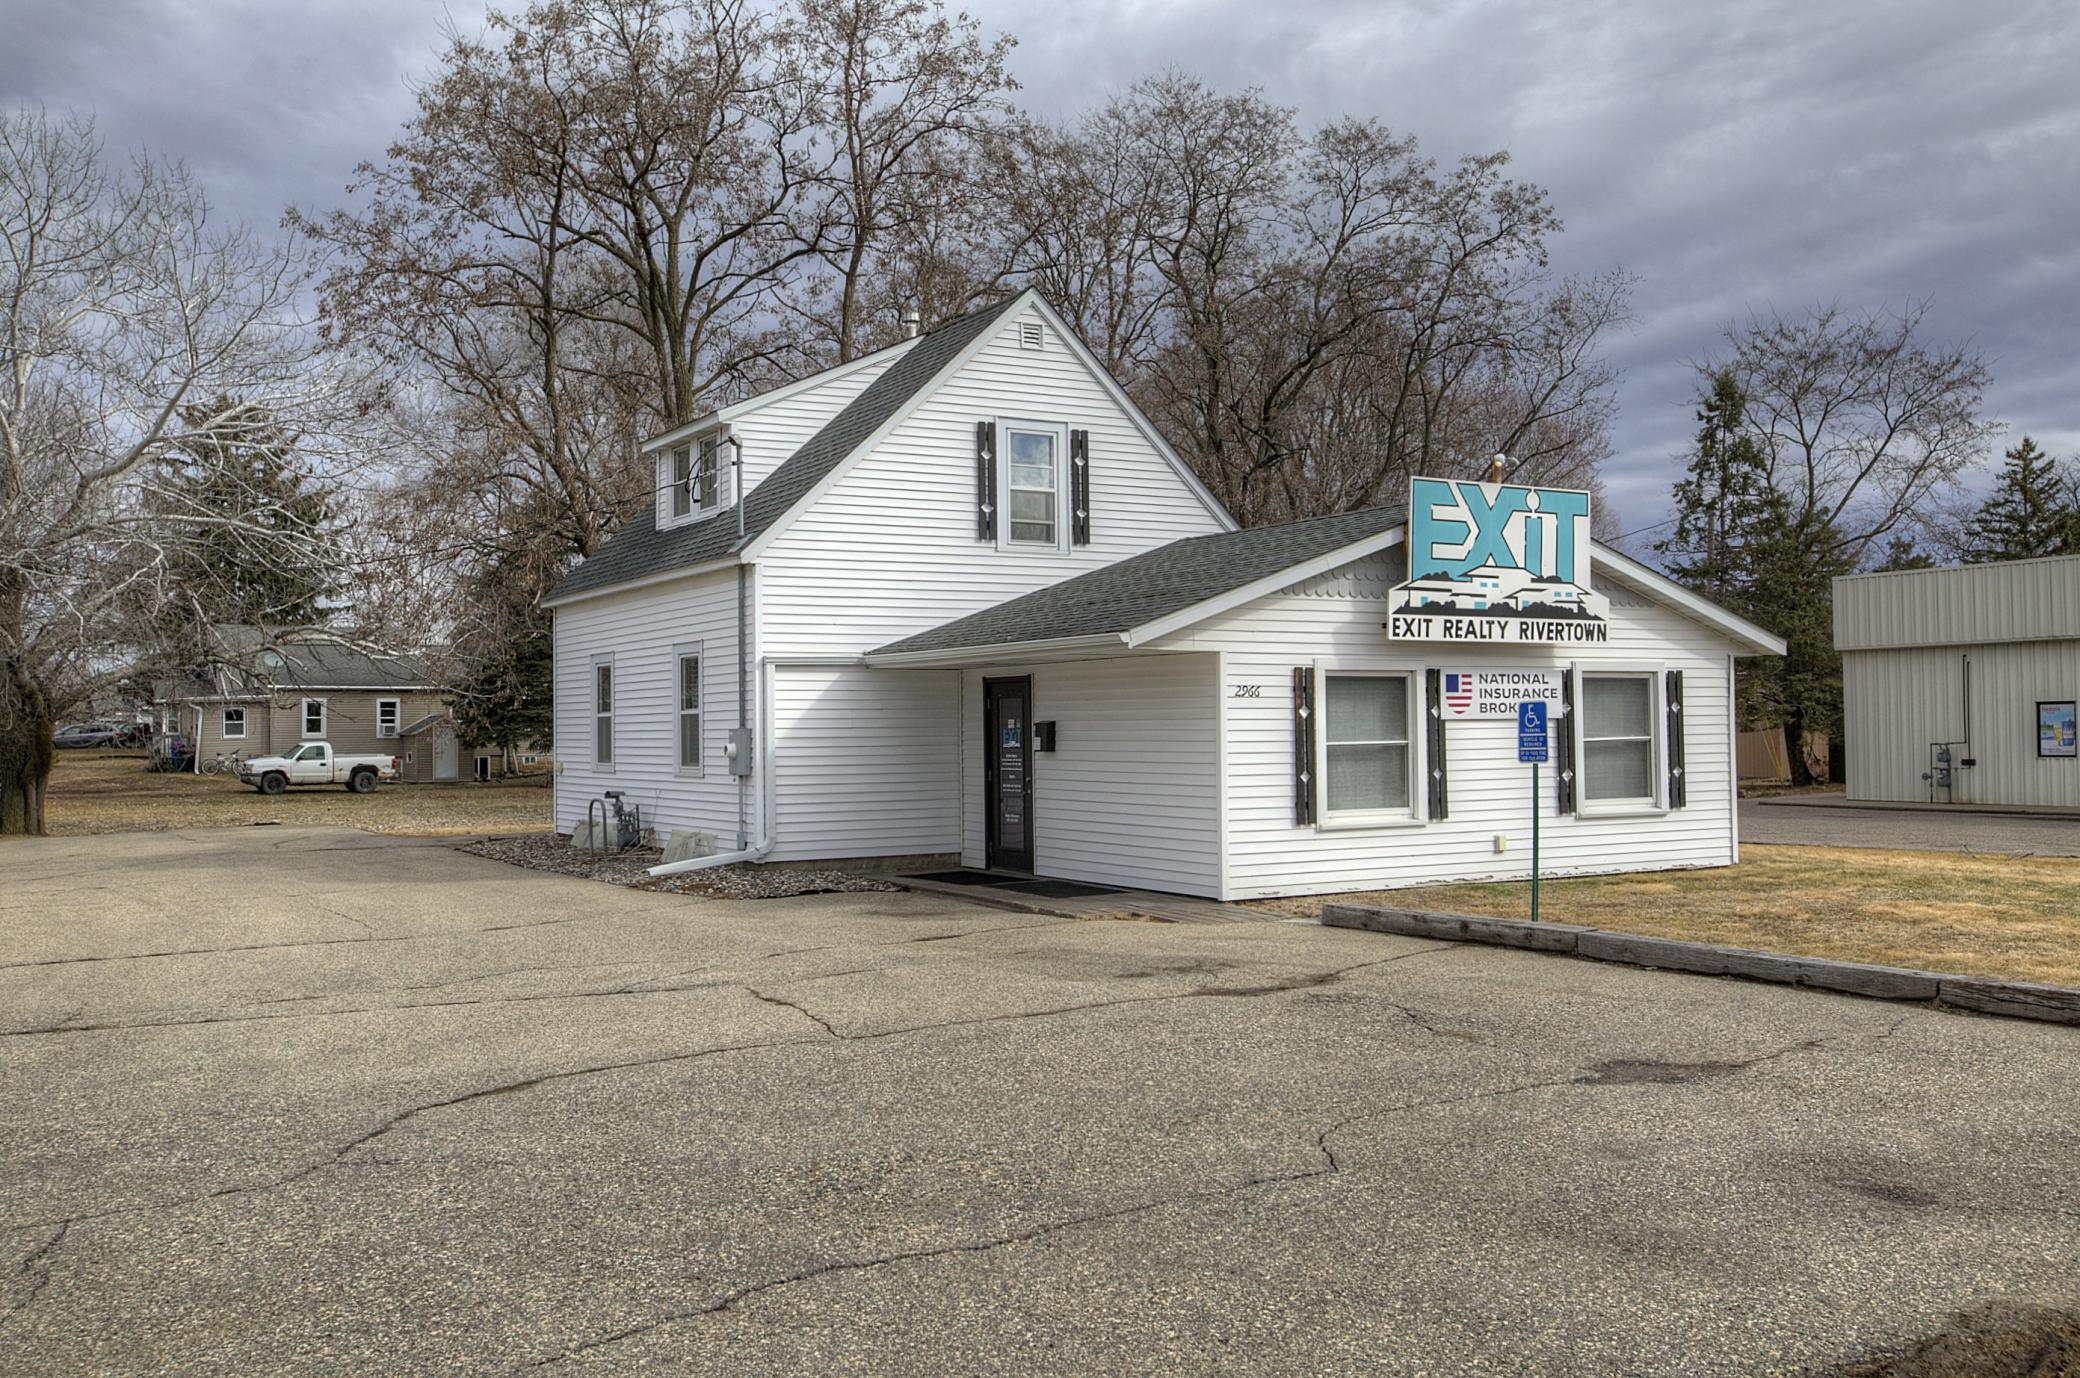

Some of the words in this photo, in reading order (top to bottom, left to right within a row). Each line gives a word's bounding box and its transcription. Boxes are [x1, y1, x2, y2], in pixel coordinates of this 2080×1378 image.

[1392, 617, 1433, 638] EXIT
[1443, 619, 1509, 640] REALTY
[1519, 621, 1607, 642] RIVERTOWN
[1479, 673, 1549, 685] NATIONAL
[1235, 685, 1261, 697] 2966
[1479, 688, 1558, 699] INSURANCE
[1479, 702, 1518, 713] BROK
